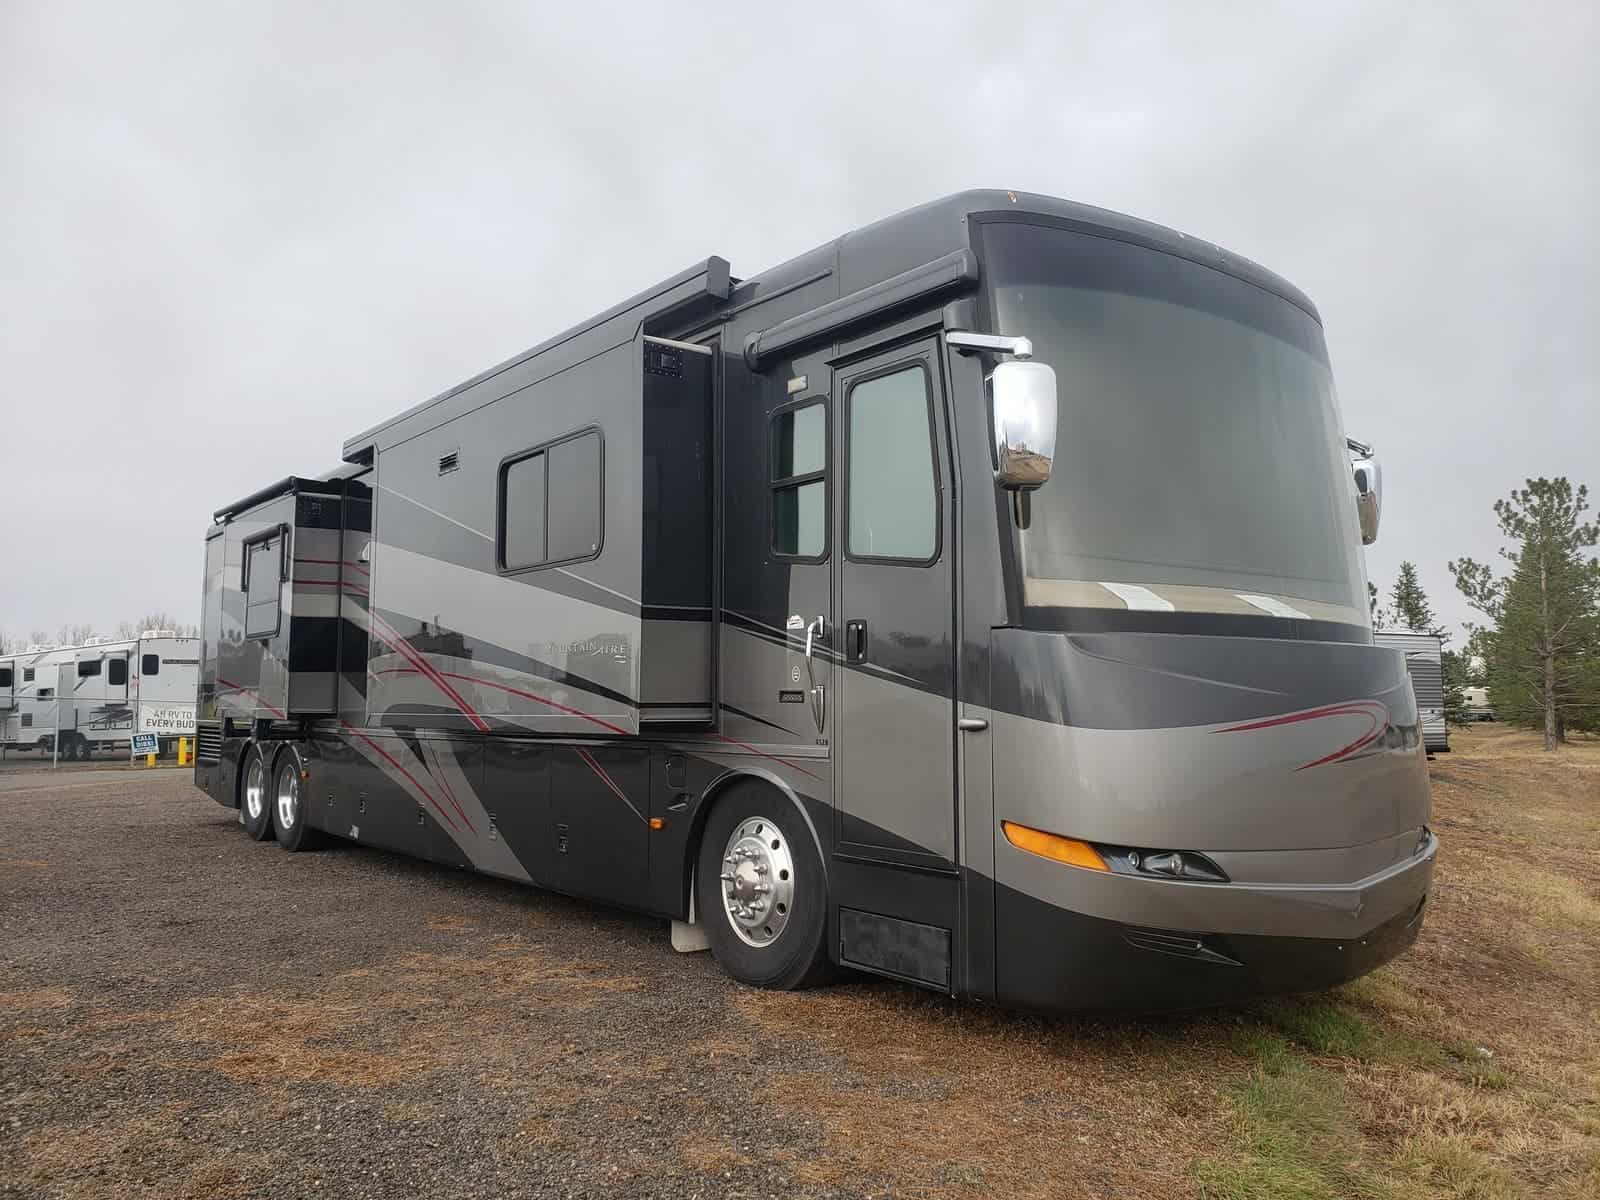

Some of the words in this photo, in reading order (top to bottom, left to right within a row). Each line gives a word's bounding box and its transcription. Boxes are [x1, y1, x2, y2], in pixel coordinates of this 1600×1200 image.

[168, 711, 180, 719] RV
[182, 711, 192, 719] TO
[146, 718, 175, 728] EVERY
